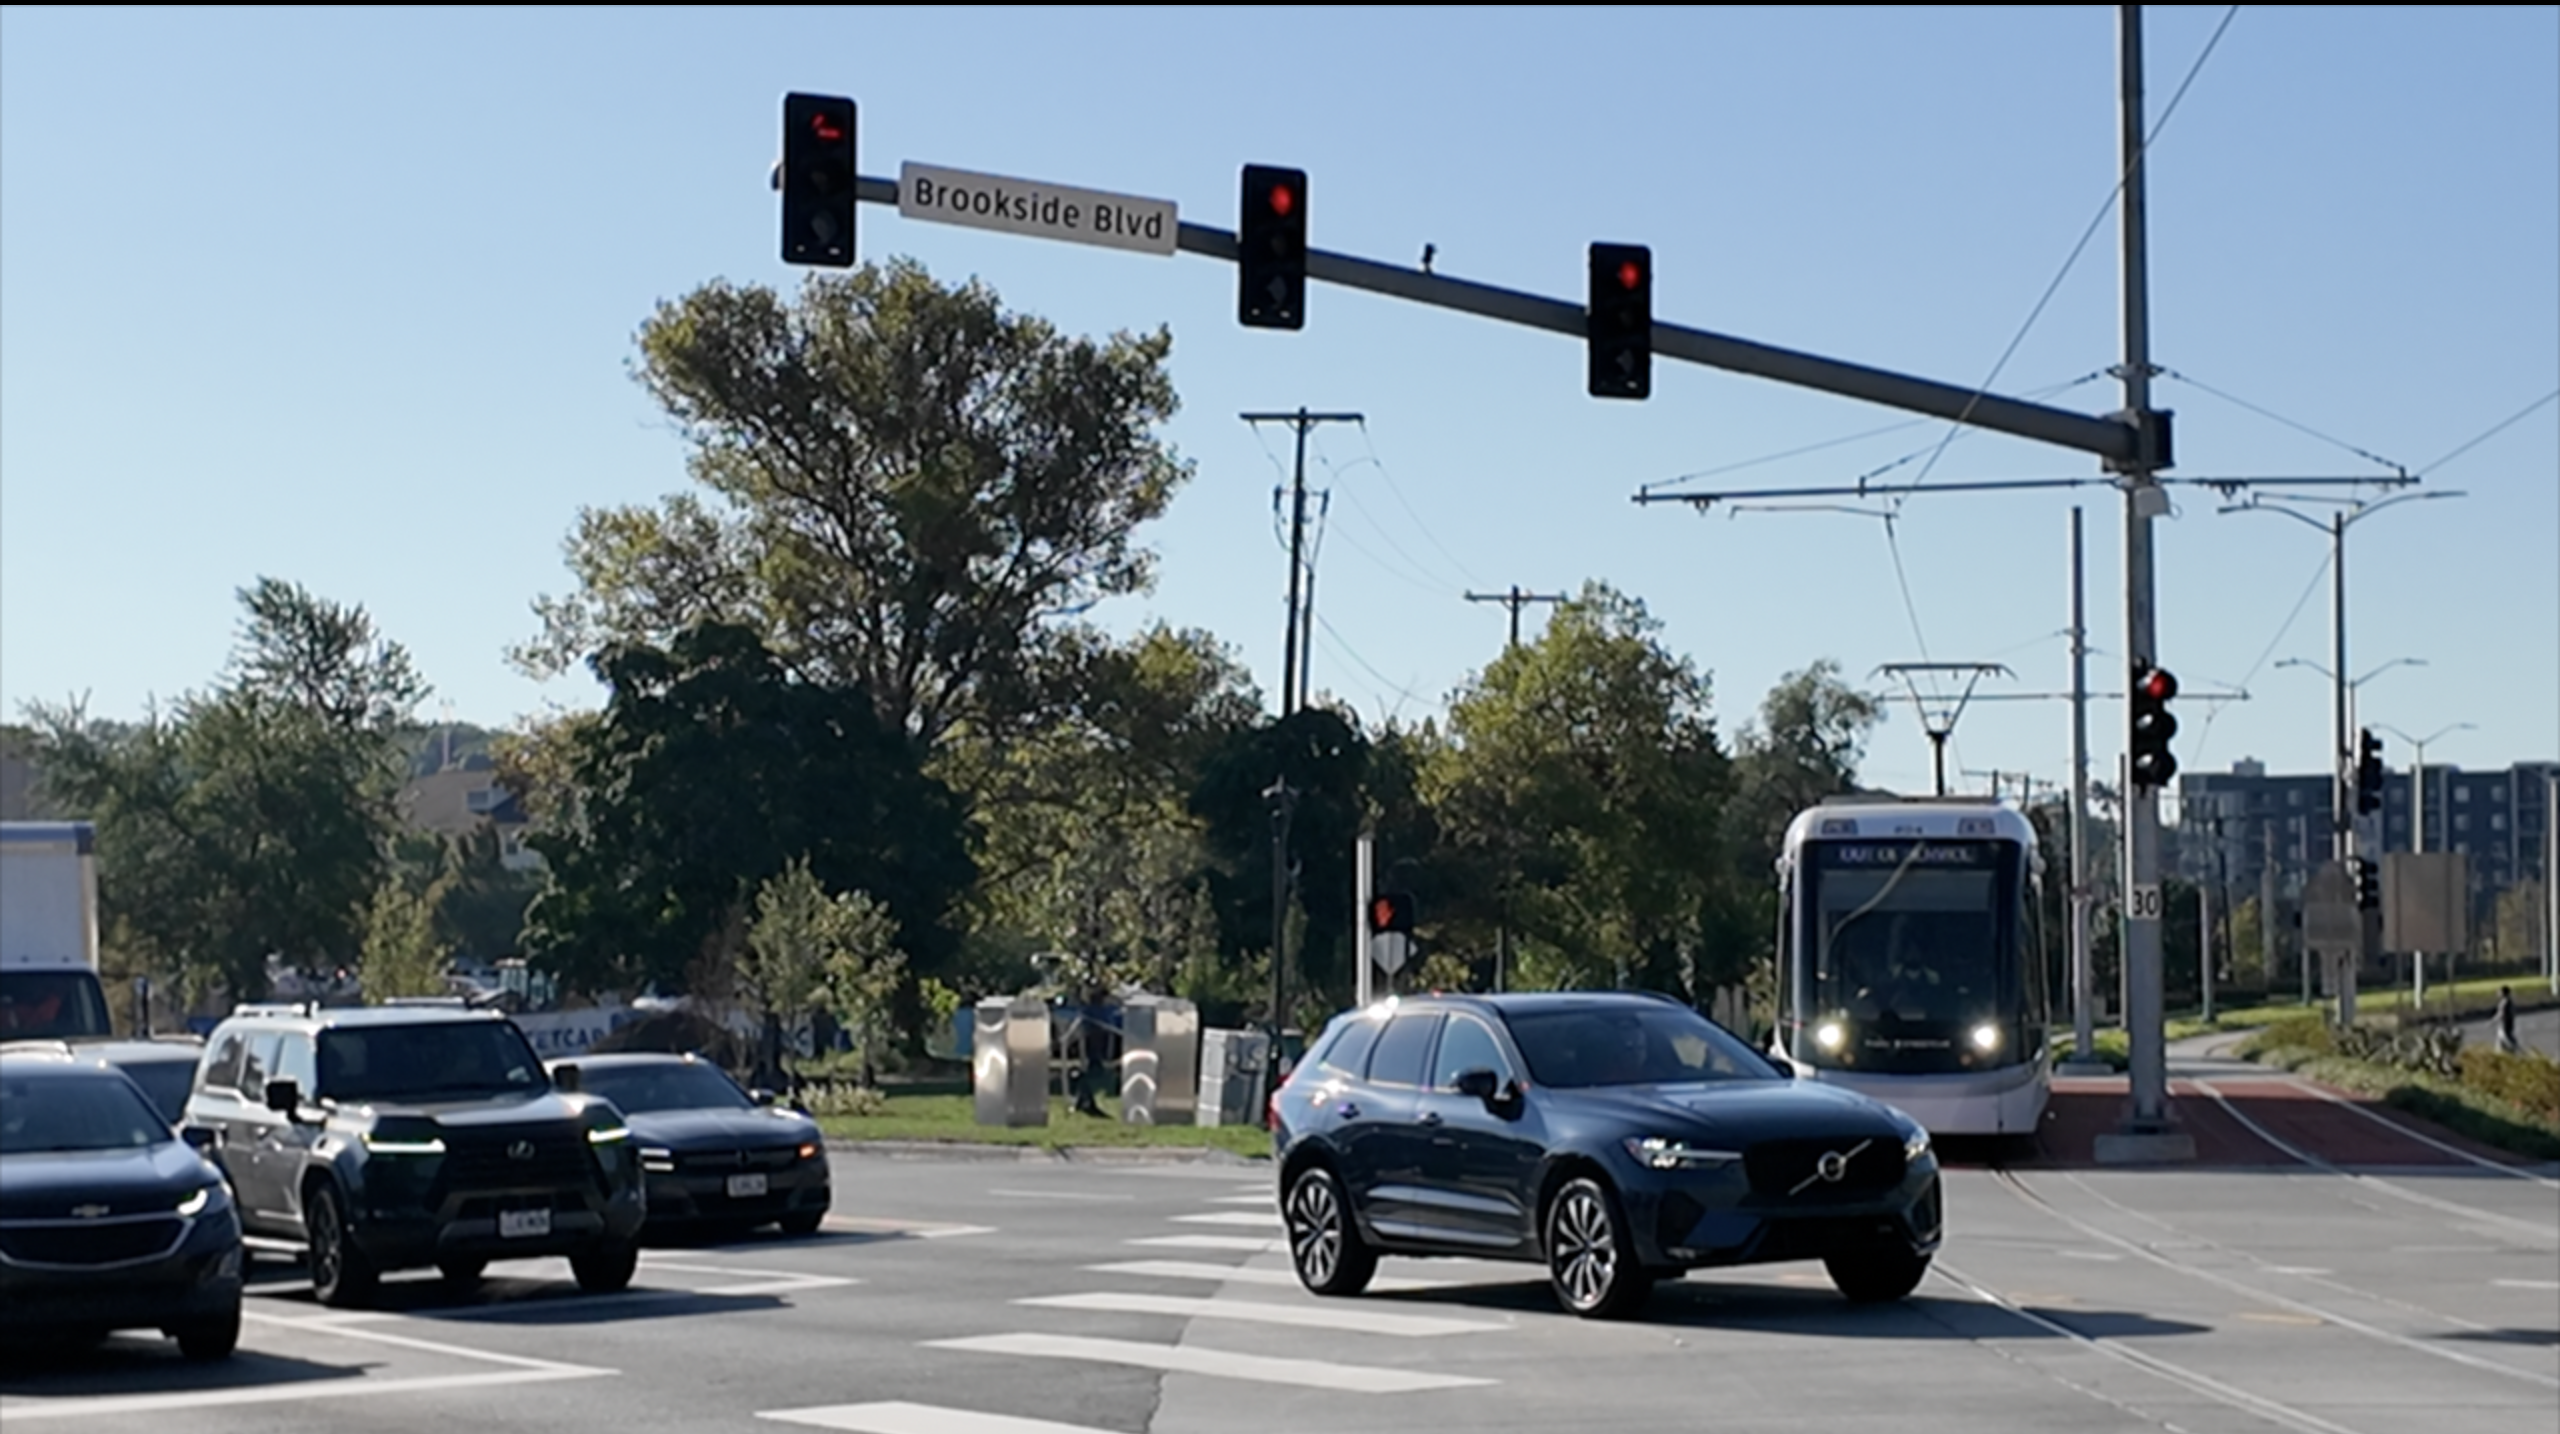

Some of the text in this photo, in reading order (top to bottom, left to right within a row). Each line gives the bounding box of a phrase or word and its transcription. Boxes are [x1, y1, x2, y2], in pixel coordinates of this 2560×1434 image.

[915, 177, 1164, 240] Brookside Blvd
[2133, 890, 2159, 916] 30
